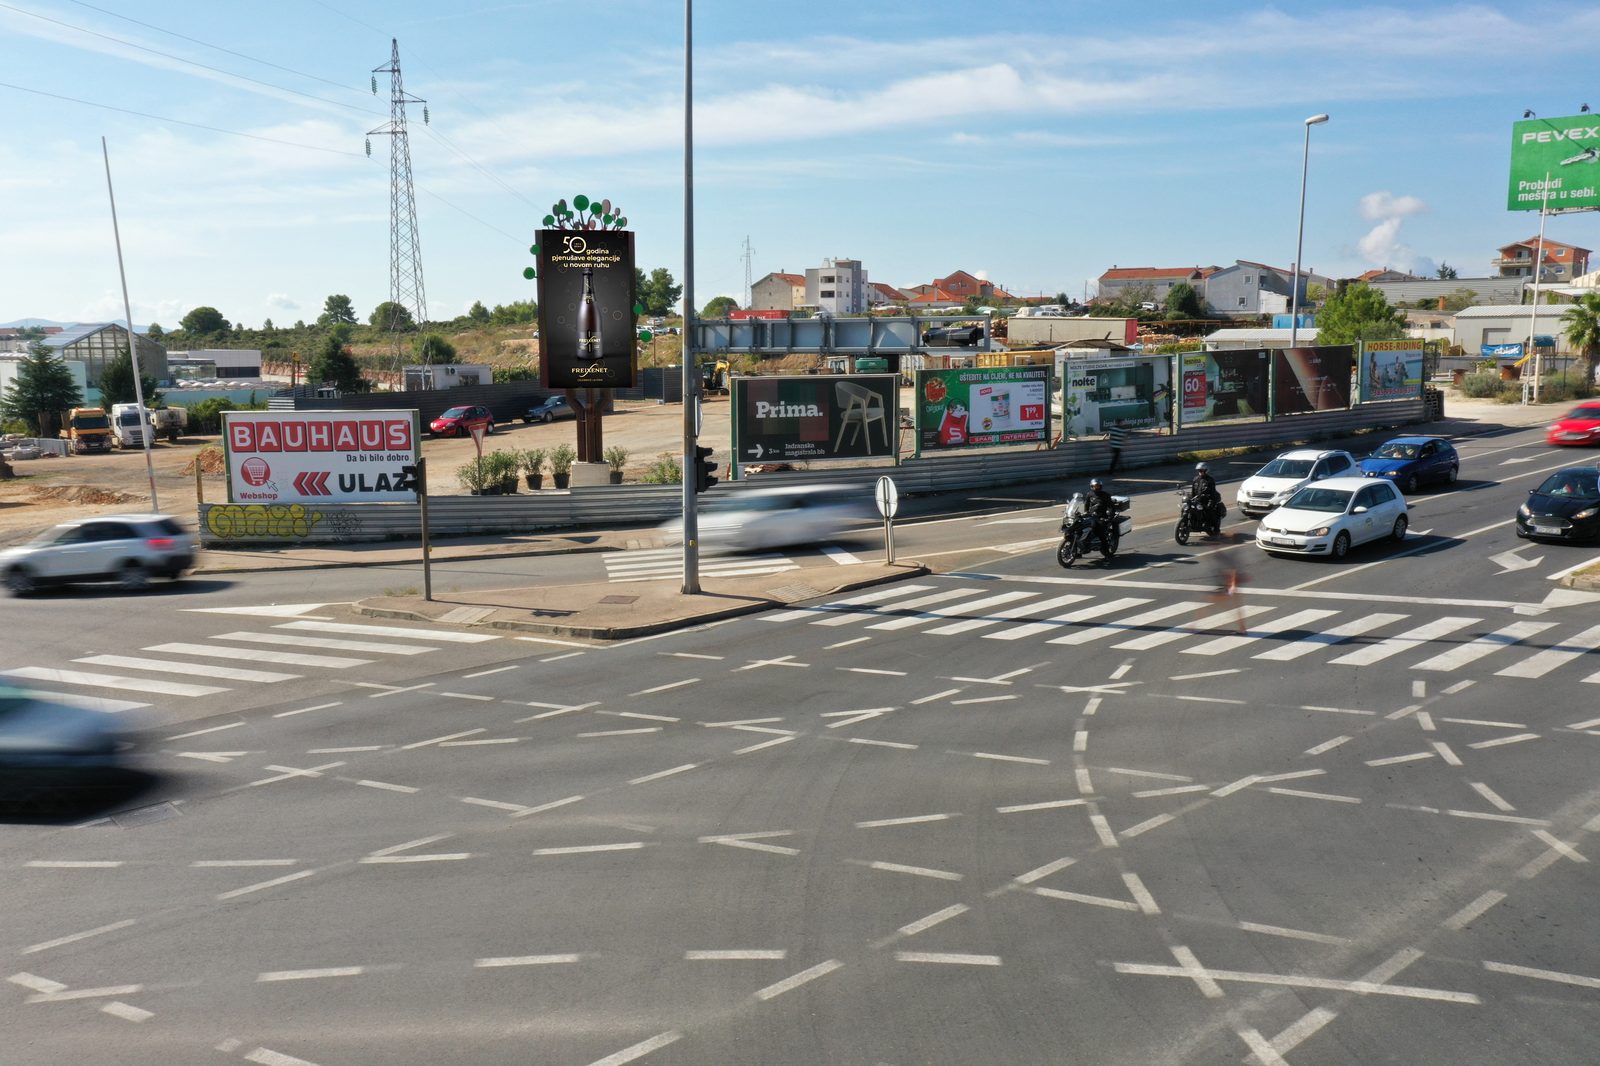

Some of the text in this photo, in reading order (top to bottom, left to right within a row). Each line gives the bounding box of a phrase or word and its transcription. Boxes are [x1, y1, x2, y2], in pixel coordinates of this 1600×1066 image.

[1522, 126, 1600, 144] PEVEX
[1519, 178, 1562, 190] Probudi
[1518, 190, 1556, 201] meštra
[1570, 186, 1597, 198] sebi.
[563, 236, 587, 254] 50
[1368, 341, 1421, 351] HORSE-RIDING
[1072, 377, 1095, 387] nolte
[756, 401, 823, 419] Prima.
[233, 424, 408, 447] BAUHAUS
[369, 454, 384, 462] bilo
[338, 473, 407, 493] ULAZ
[240, 492, 278, 500] Webshop
